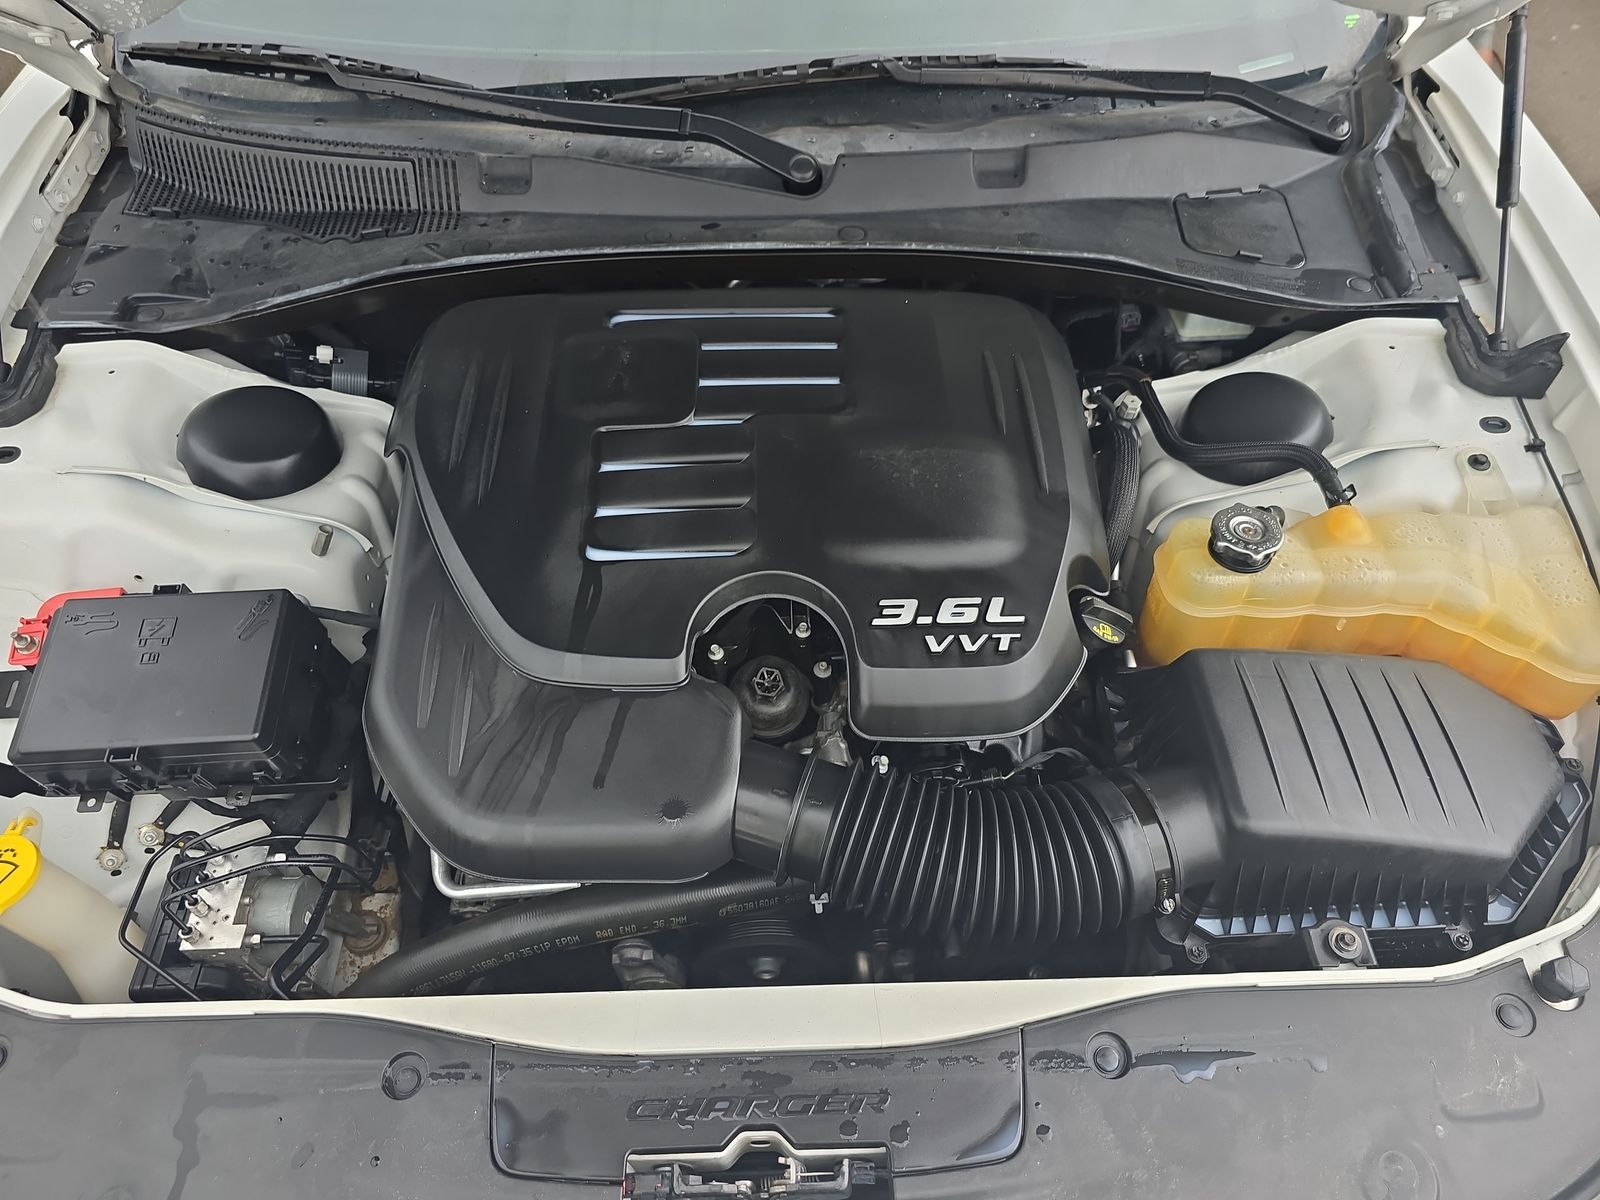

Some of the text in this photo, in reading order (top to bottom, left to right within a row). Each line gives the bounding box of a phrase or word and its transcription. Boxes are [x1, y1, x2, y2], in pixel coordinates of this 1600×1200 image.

[871, 597, 1026, 627] 3.6L
[925, 633, 1021, 654] VVT
[595, 926, 614, 939] RAD
[619, 924, 638, 935] END
[626, 1090, 891, 1122] CHARGER
